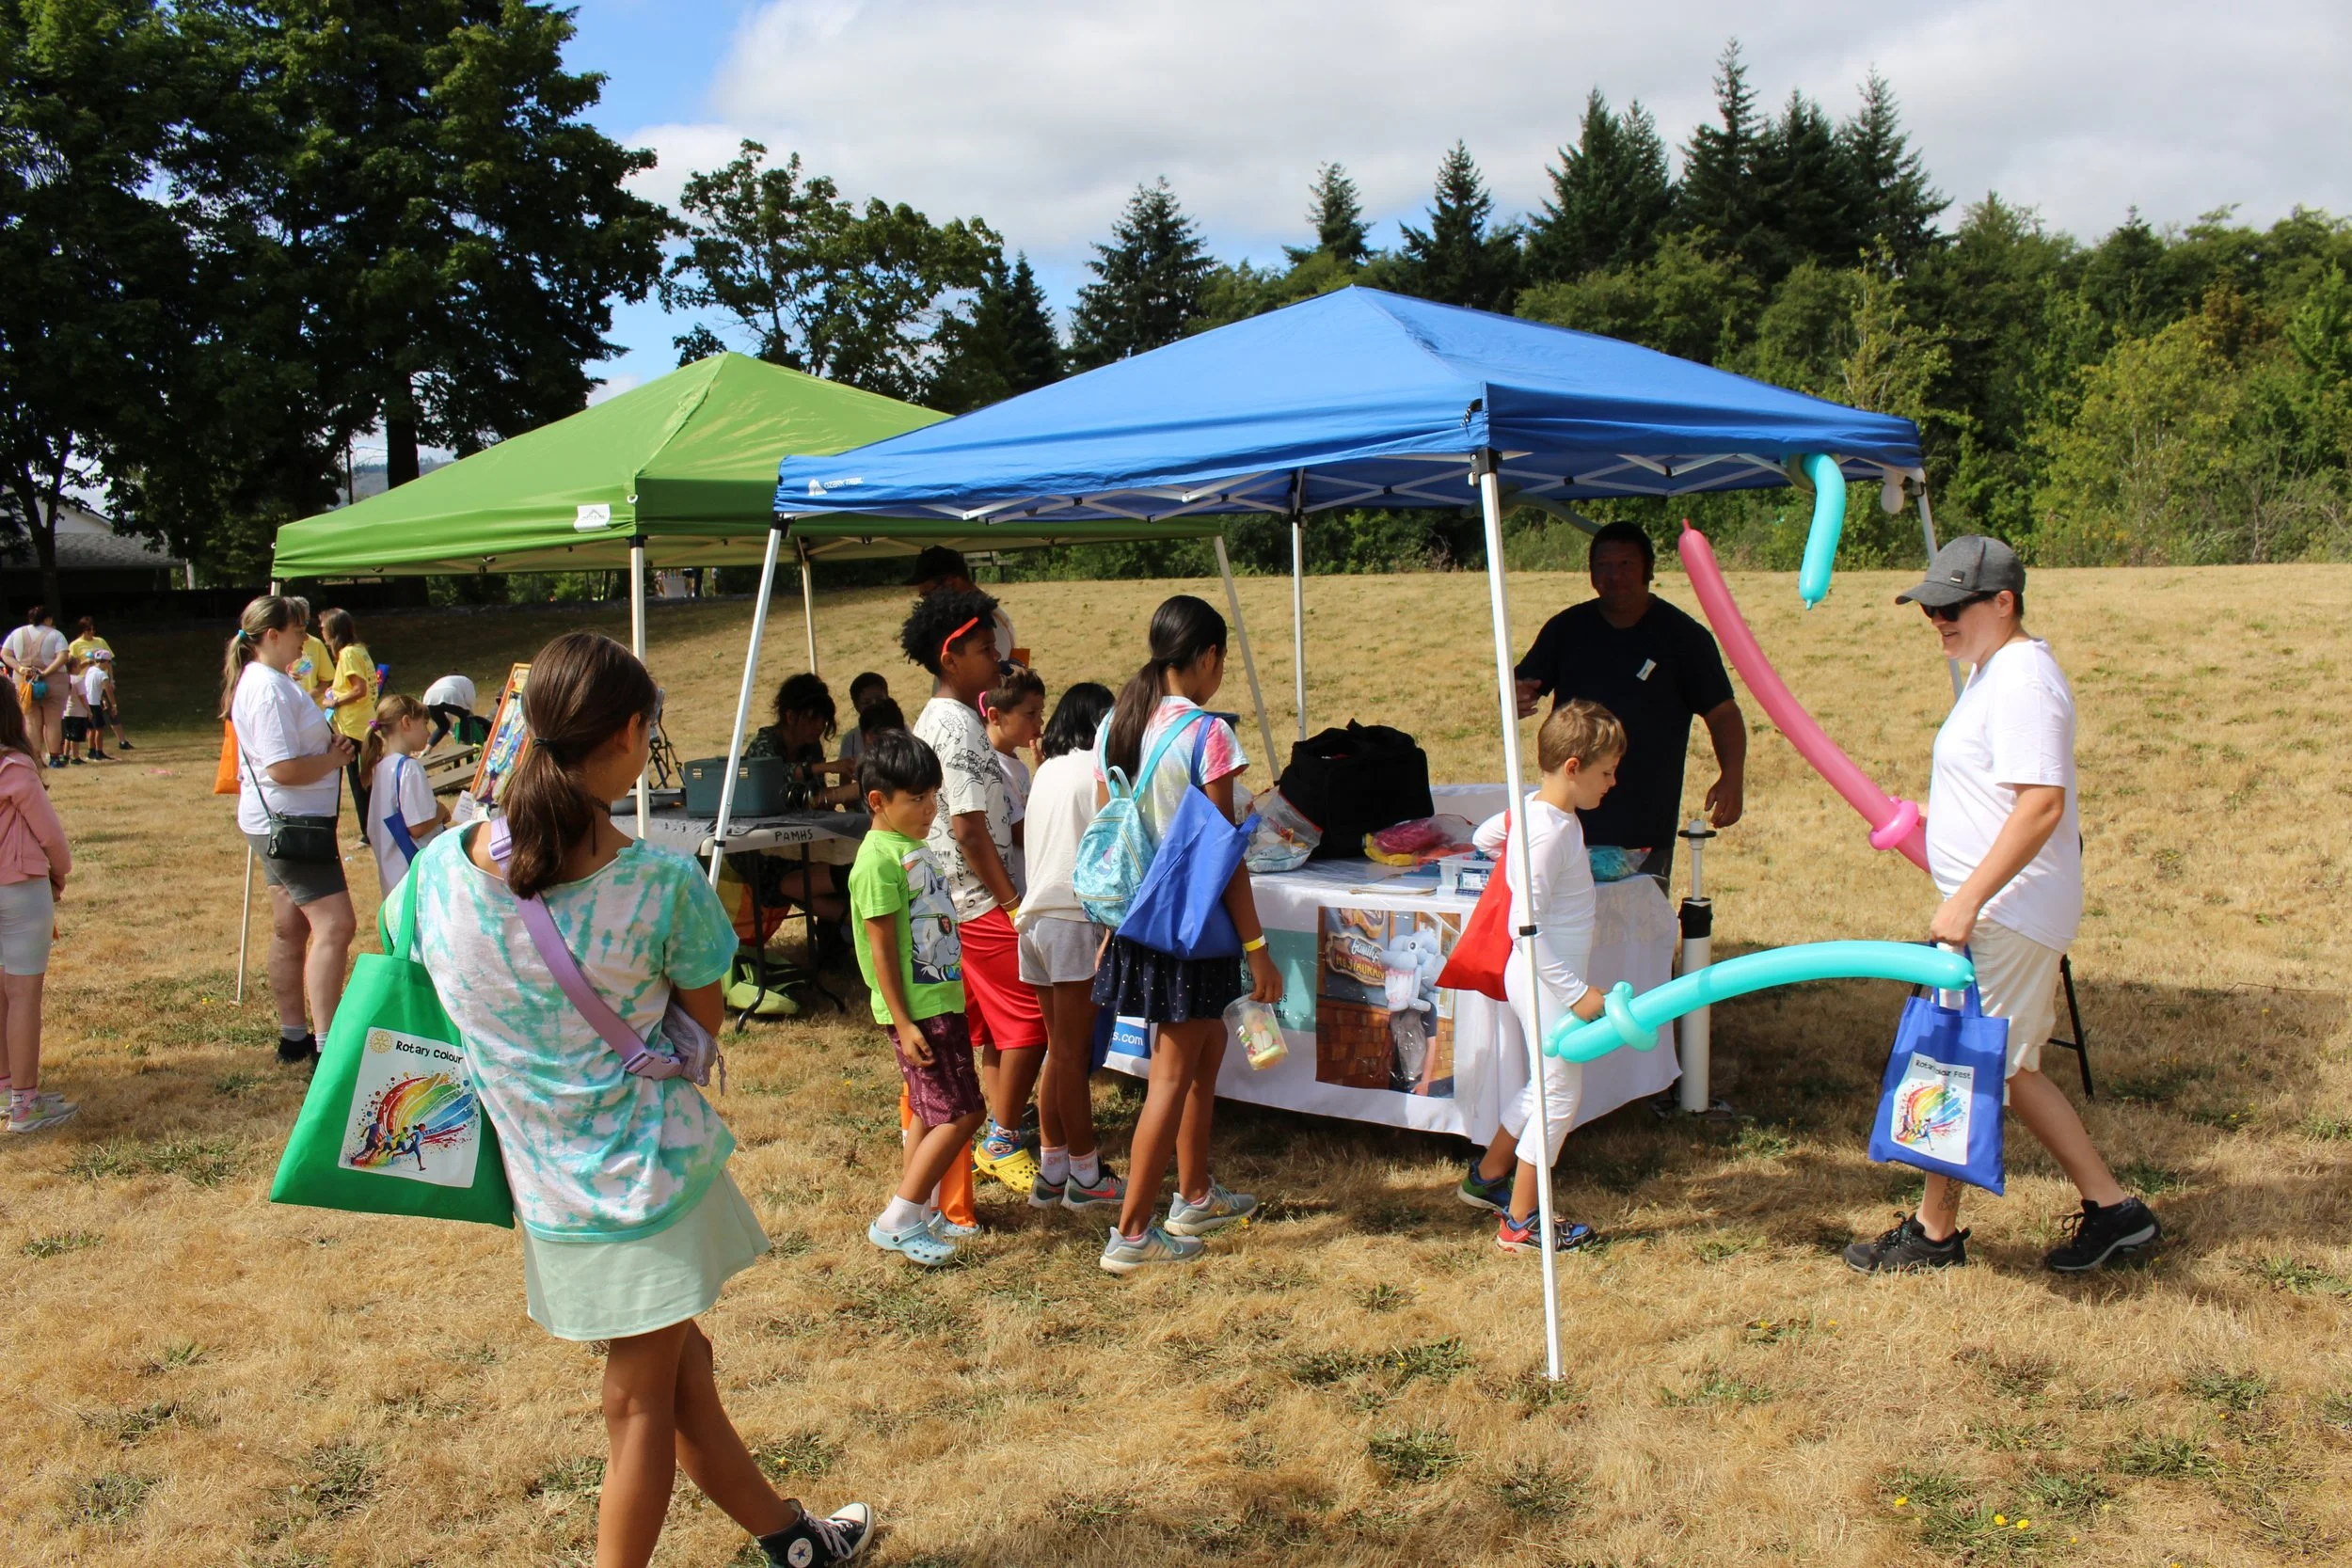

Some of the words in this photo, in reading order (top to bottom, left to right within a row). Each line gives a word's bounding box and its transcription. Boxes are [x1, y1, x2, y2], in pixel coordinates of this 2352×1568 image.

[774, 829, 814, 842] PAMHS
[1335, 955, 1386, 979] RESTAURAN
[395, 1039, 431, 1057] Rotary
[433, 1049, 464, 1064] Colour
[1953, 1070, 1972, 1079] Fest
